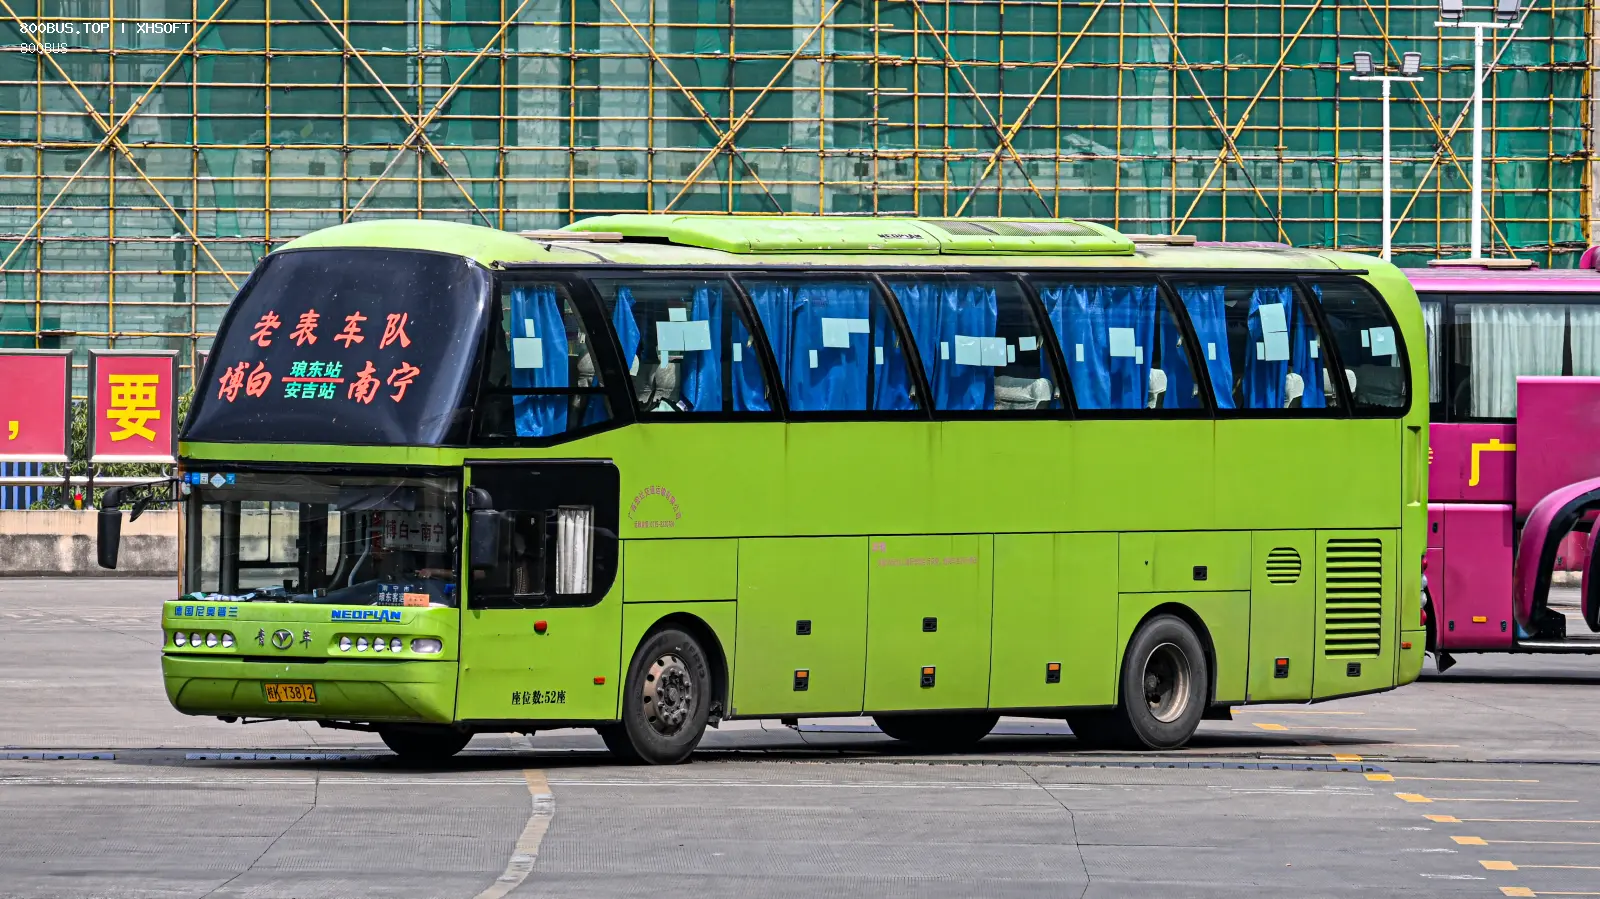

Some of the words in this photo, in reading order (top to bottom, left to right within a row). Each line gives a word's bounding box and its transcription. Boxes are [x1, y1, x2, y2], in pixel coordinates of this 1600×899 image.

[250, 308, 412, 350] 老表车队
[218, 361, 272, 403] 博白
[290, 360, 343, 378] 琅东站
[347, 360, 420, 405] 南宁
[106, 374, 161, 441] 要
[284, 382, 337, 399] 安吉站
[331, 609, 402, 622] NEOPLAN
